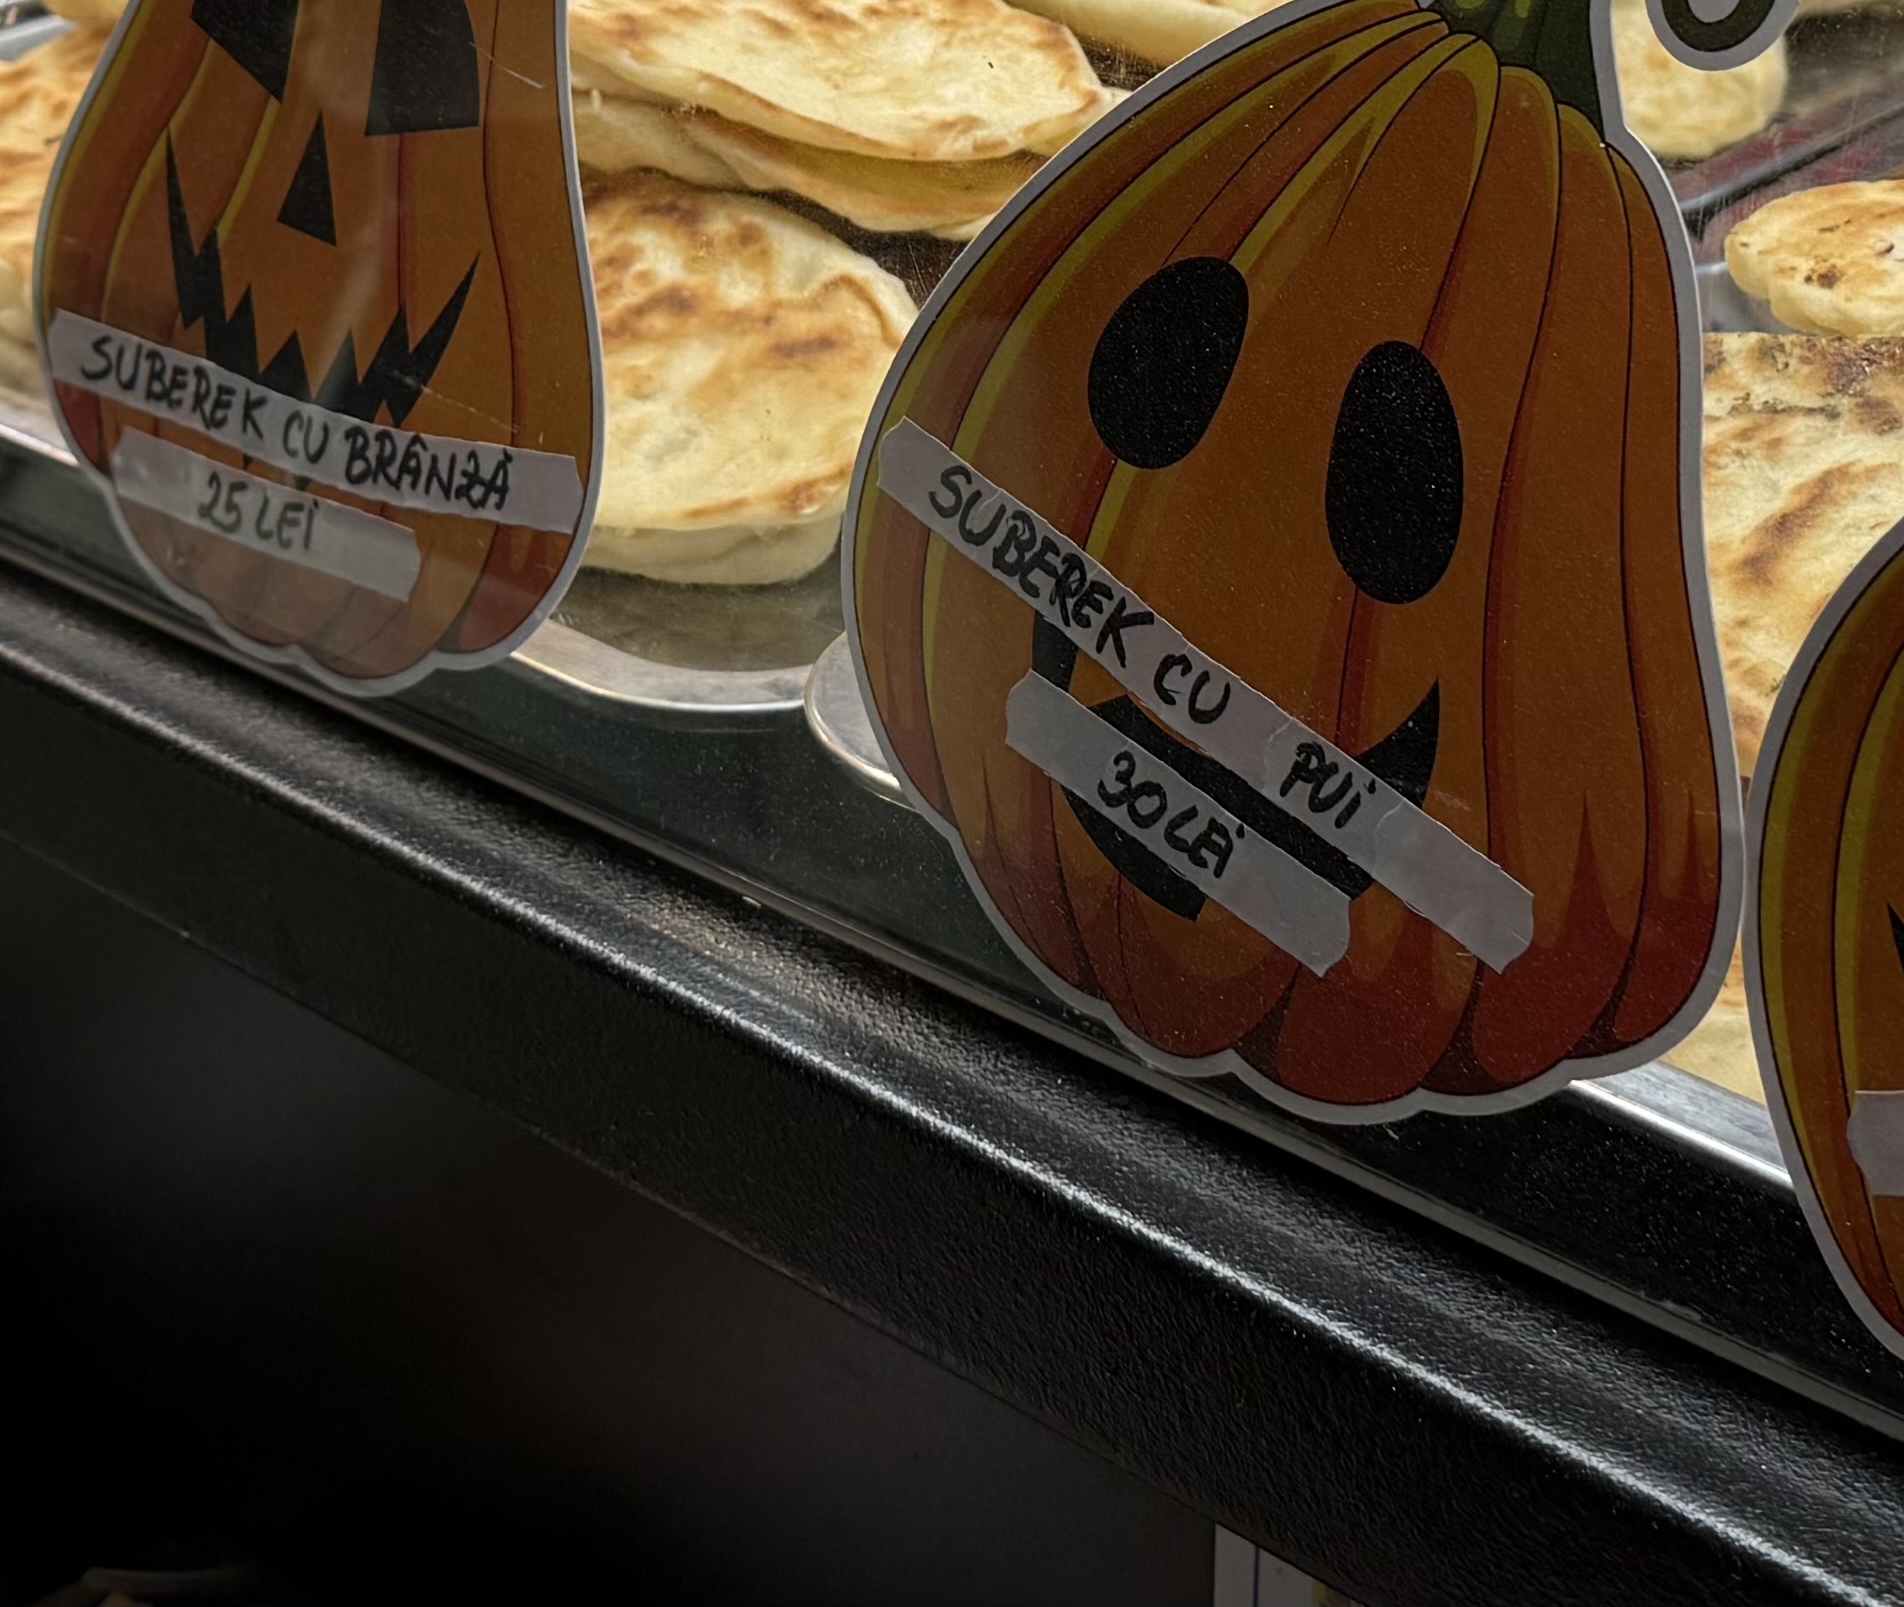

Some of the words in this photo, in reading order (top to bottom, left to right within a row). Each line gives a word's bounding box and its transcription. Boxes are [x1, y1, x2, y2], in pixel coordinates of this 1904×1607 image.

[80, 335, 264, 440] SUBEREK
[282, 407, 330, 464] CU
[344, 424, 513, 511] BRÂNZĂ
[198, 471, 249, 533] 25
[255, 494, 320, 552] LEI
[928, 465, 1154, 668] SUBEREK
[1152, 653, 1231, 725] CU
